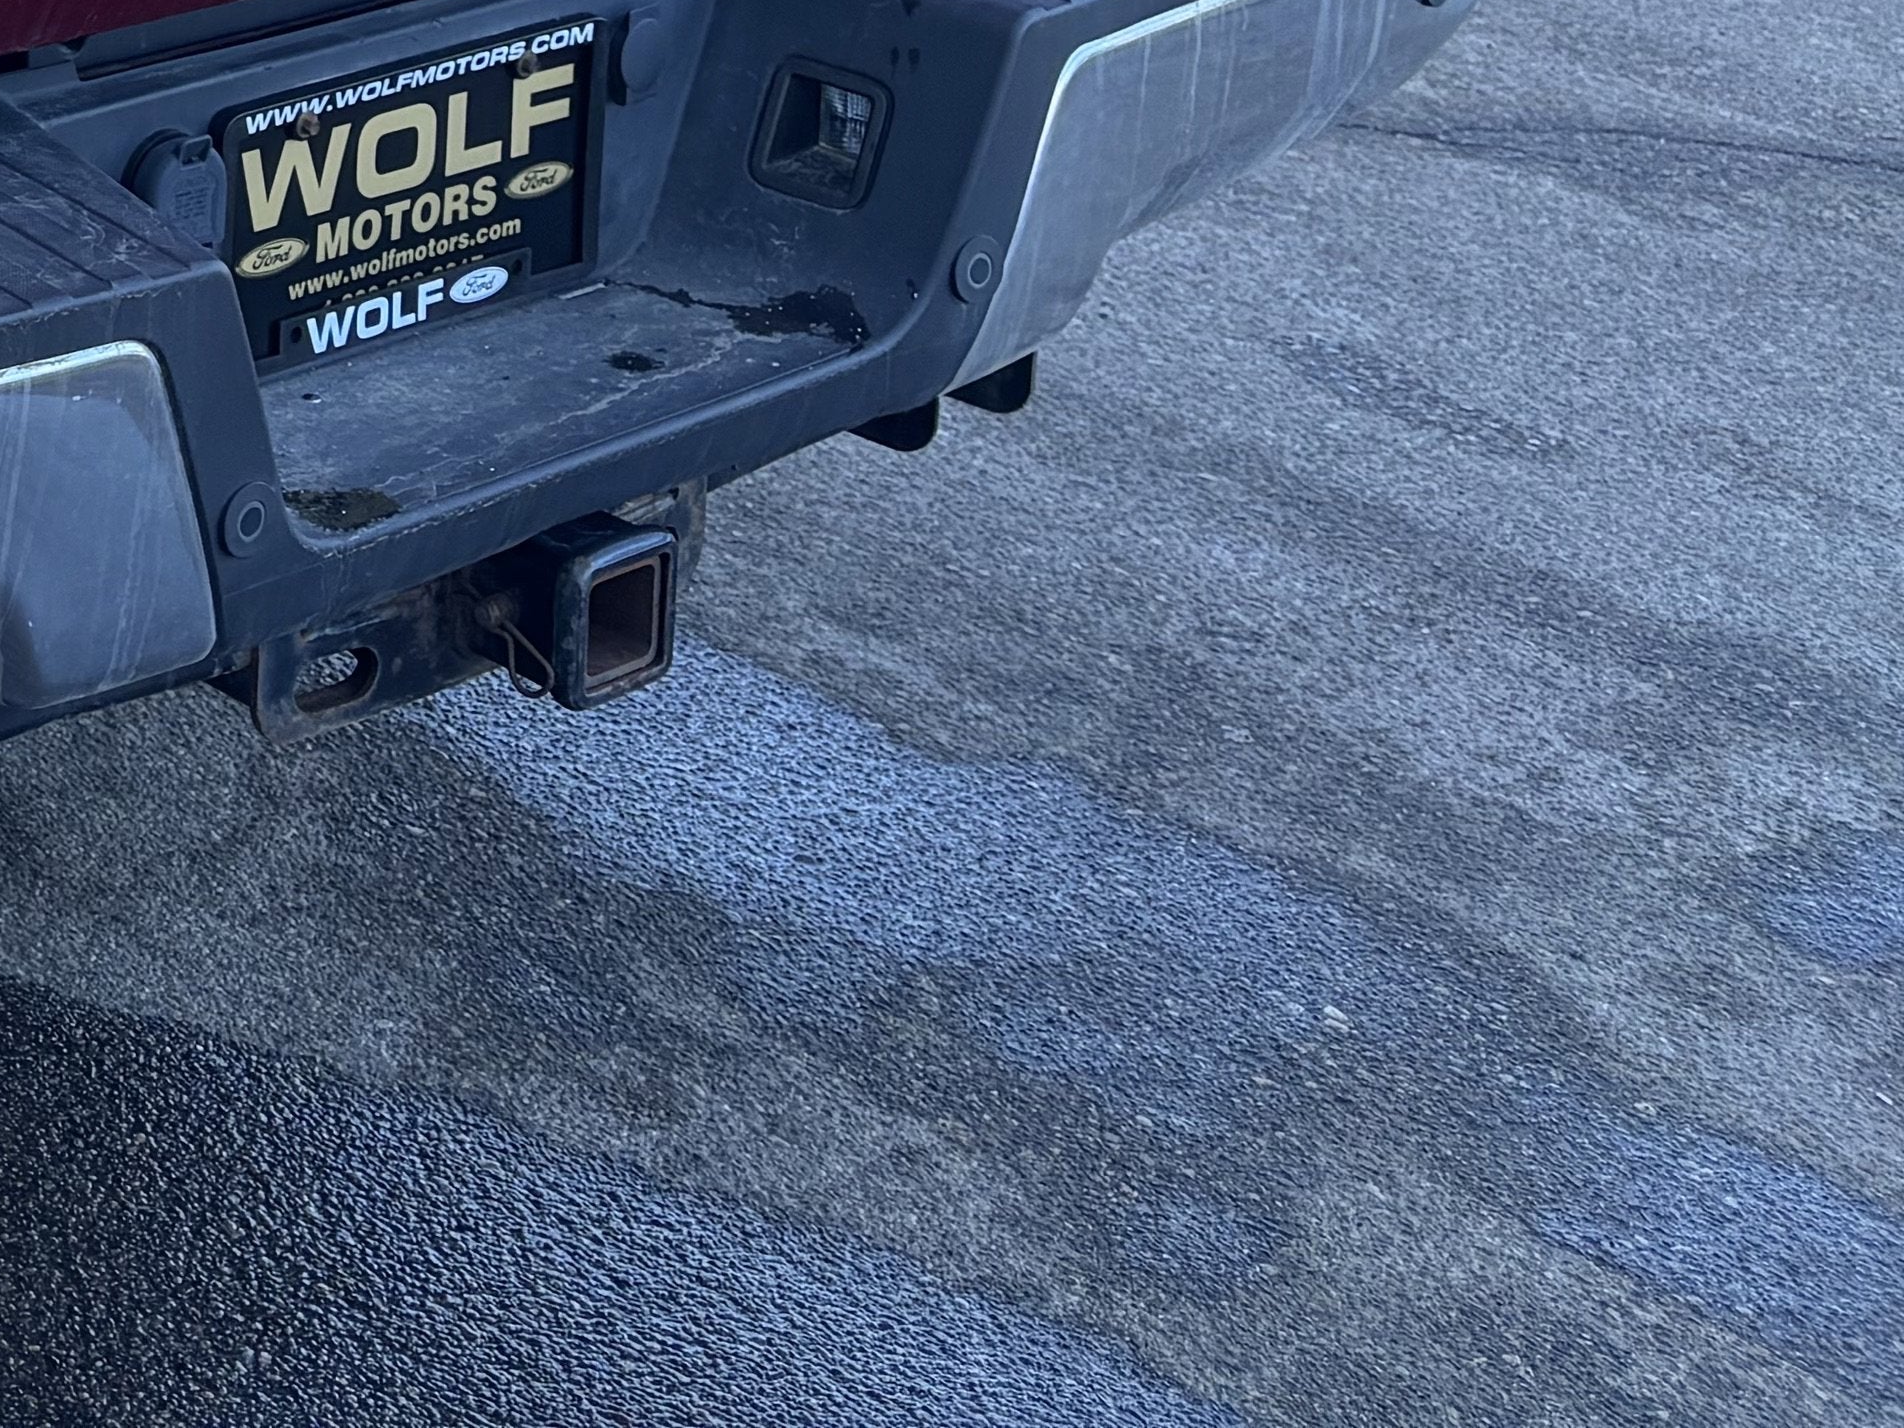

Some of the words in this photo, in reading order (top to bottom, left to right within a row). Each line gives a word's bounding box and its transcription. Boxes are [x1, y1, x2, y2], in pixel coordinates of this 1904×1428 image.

[246, 22, 595, 135] WWW.WOLFMOTORSCOM
[241, 63, 576, 232] WOLF
[288, 218, 522, 301] www.wolfmotors.com
[315, 175, 497, 263] MOTORS
[306, 278, 444, 354] WOLF
